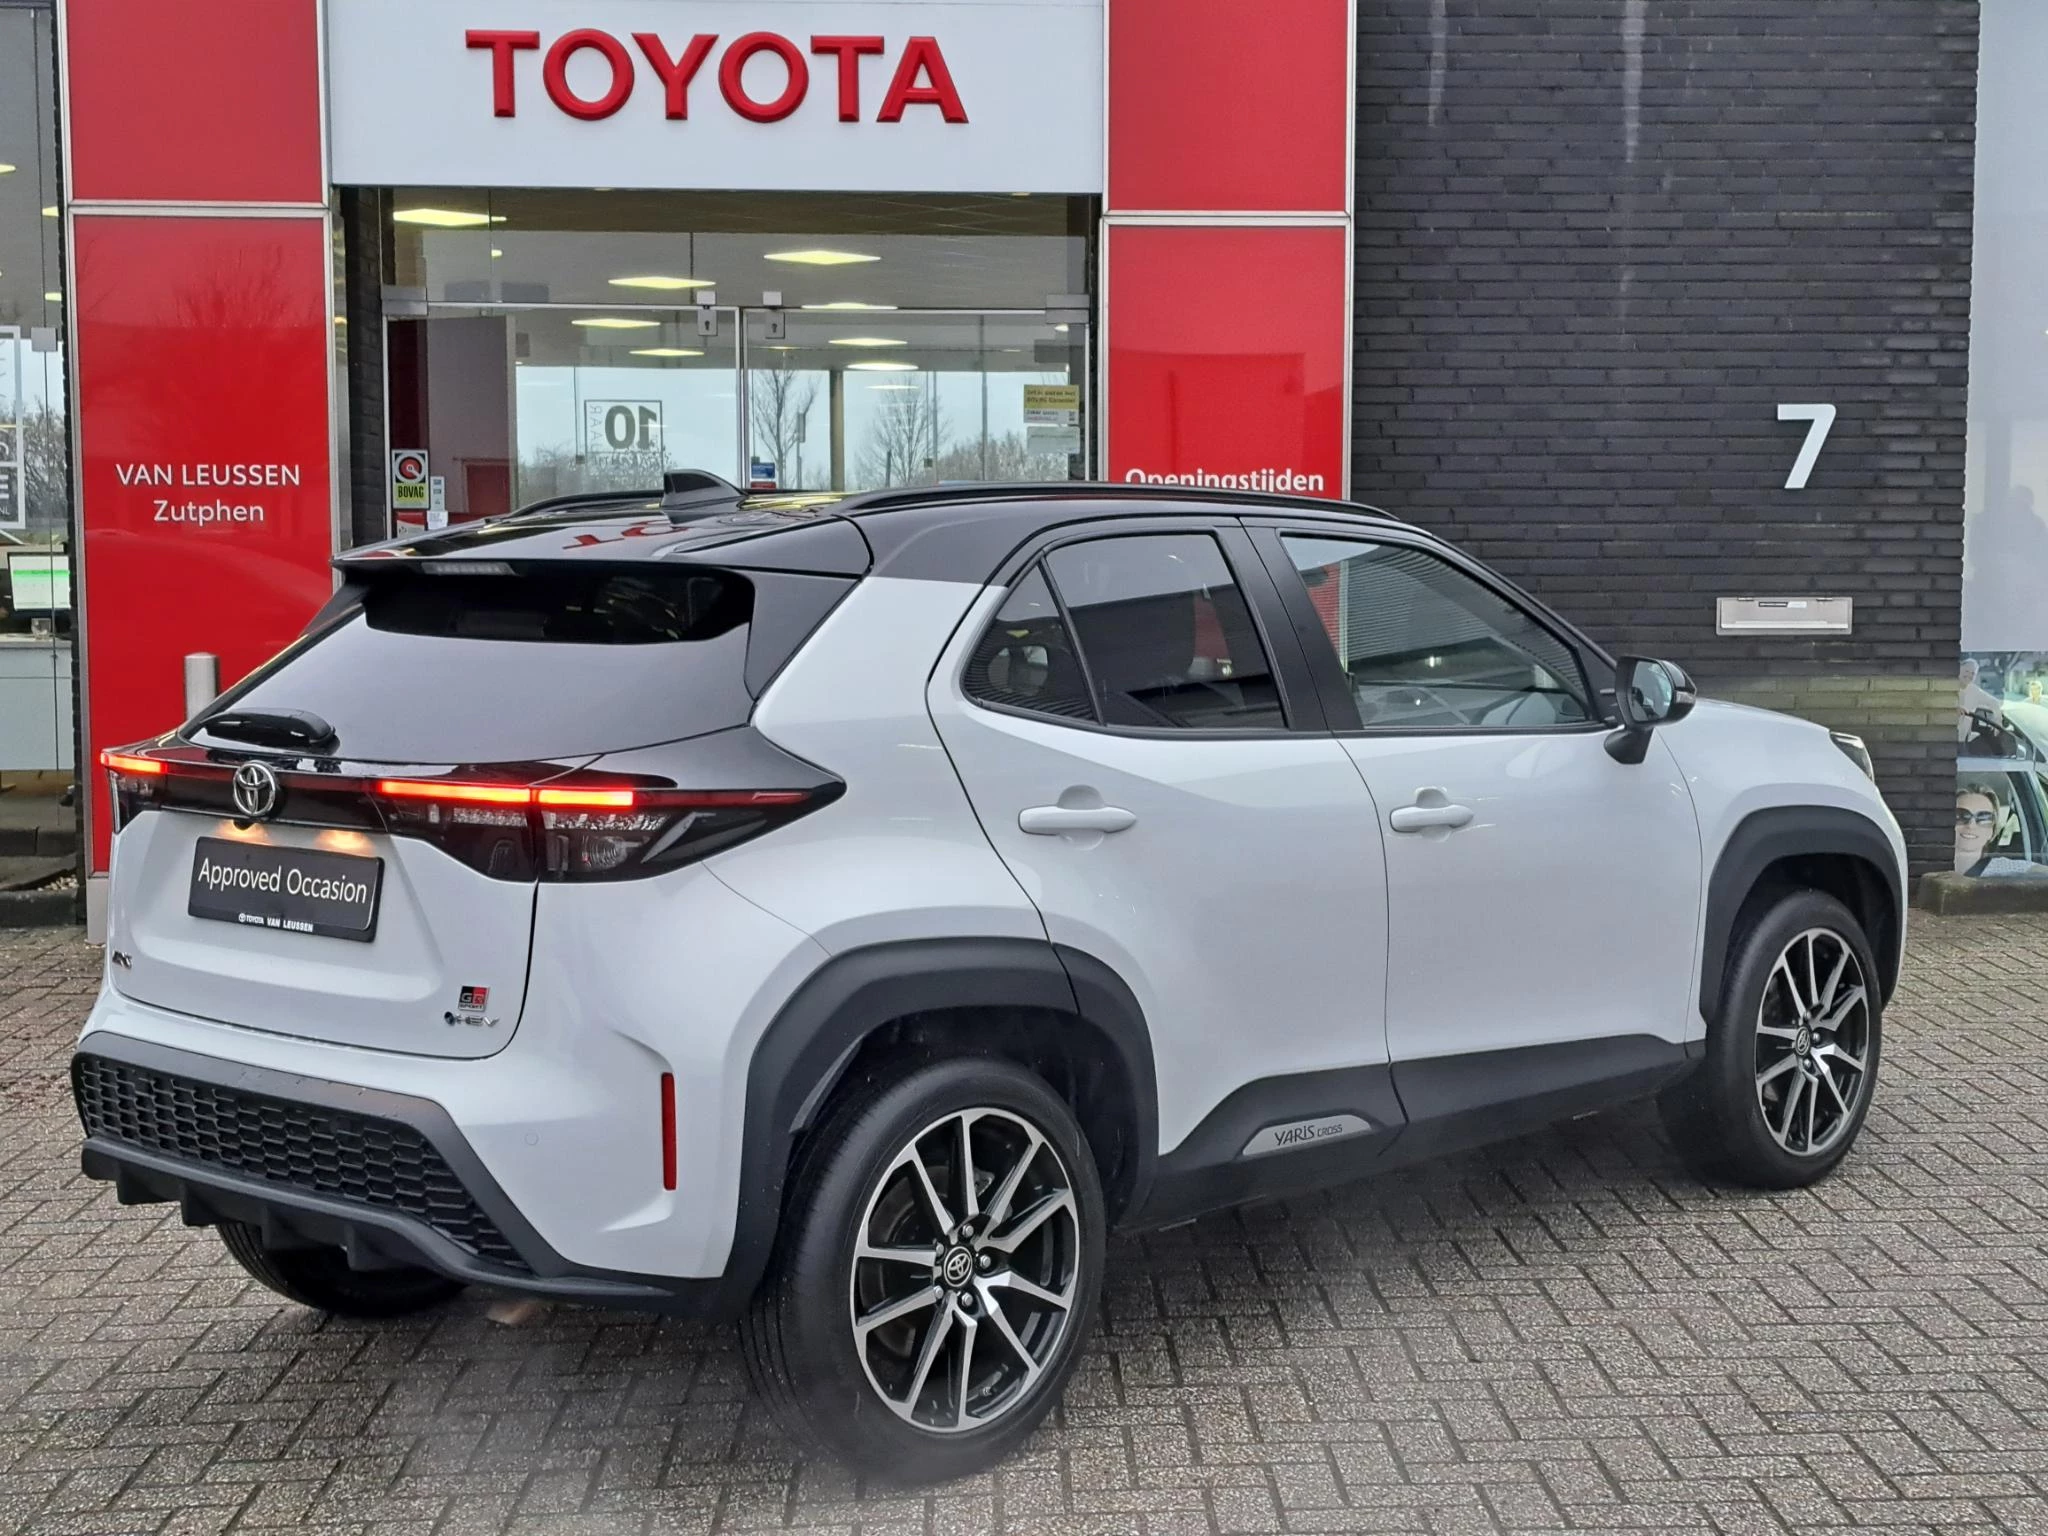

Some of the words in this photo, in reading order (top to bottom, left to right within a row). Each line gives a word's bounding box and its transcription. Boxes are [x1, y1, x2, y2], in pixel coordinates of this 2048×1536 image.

[465, 28, 969, 124] TOYOTA
[1777, 403, 1837, 489] 7
[115, 463, 173, 487] VAN
[181, 463, 301, 487] LEUSSEN
[397, 485, 425, 498] BOVAG
[152, 499, 265, 527] Zutphen
[197, 856, 282, 893] Approved
[286, 868, 368, 904] Occasion
[246, 914, 265, 925] TOYOTA
[266, 916, 281, 929] VAN
[282, 919, 314, 933] LEUSSEN
[1274, 1124, 1316, 1146] YARIS
[1317, 1123, 1343, 1138] CROSS
